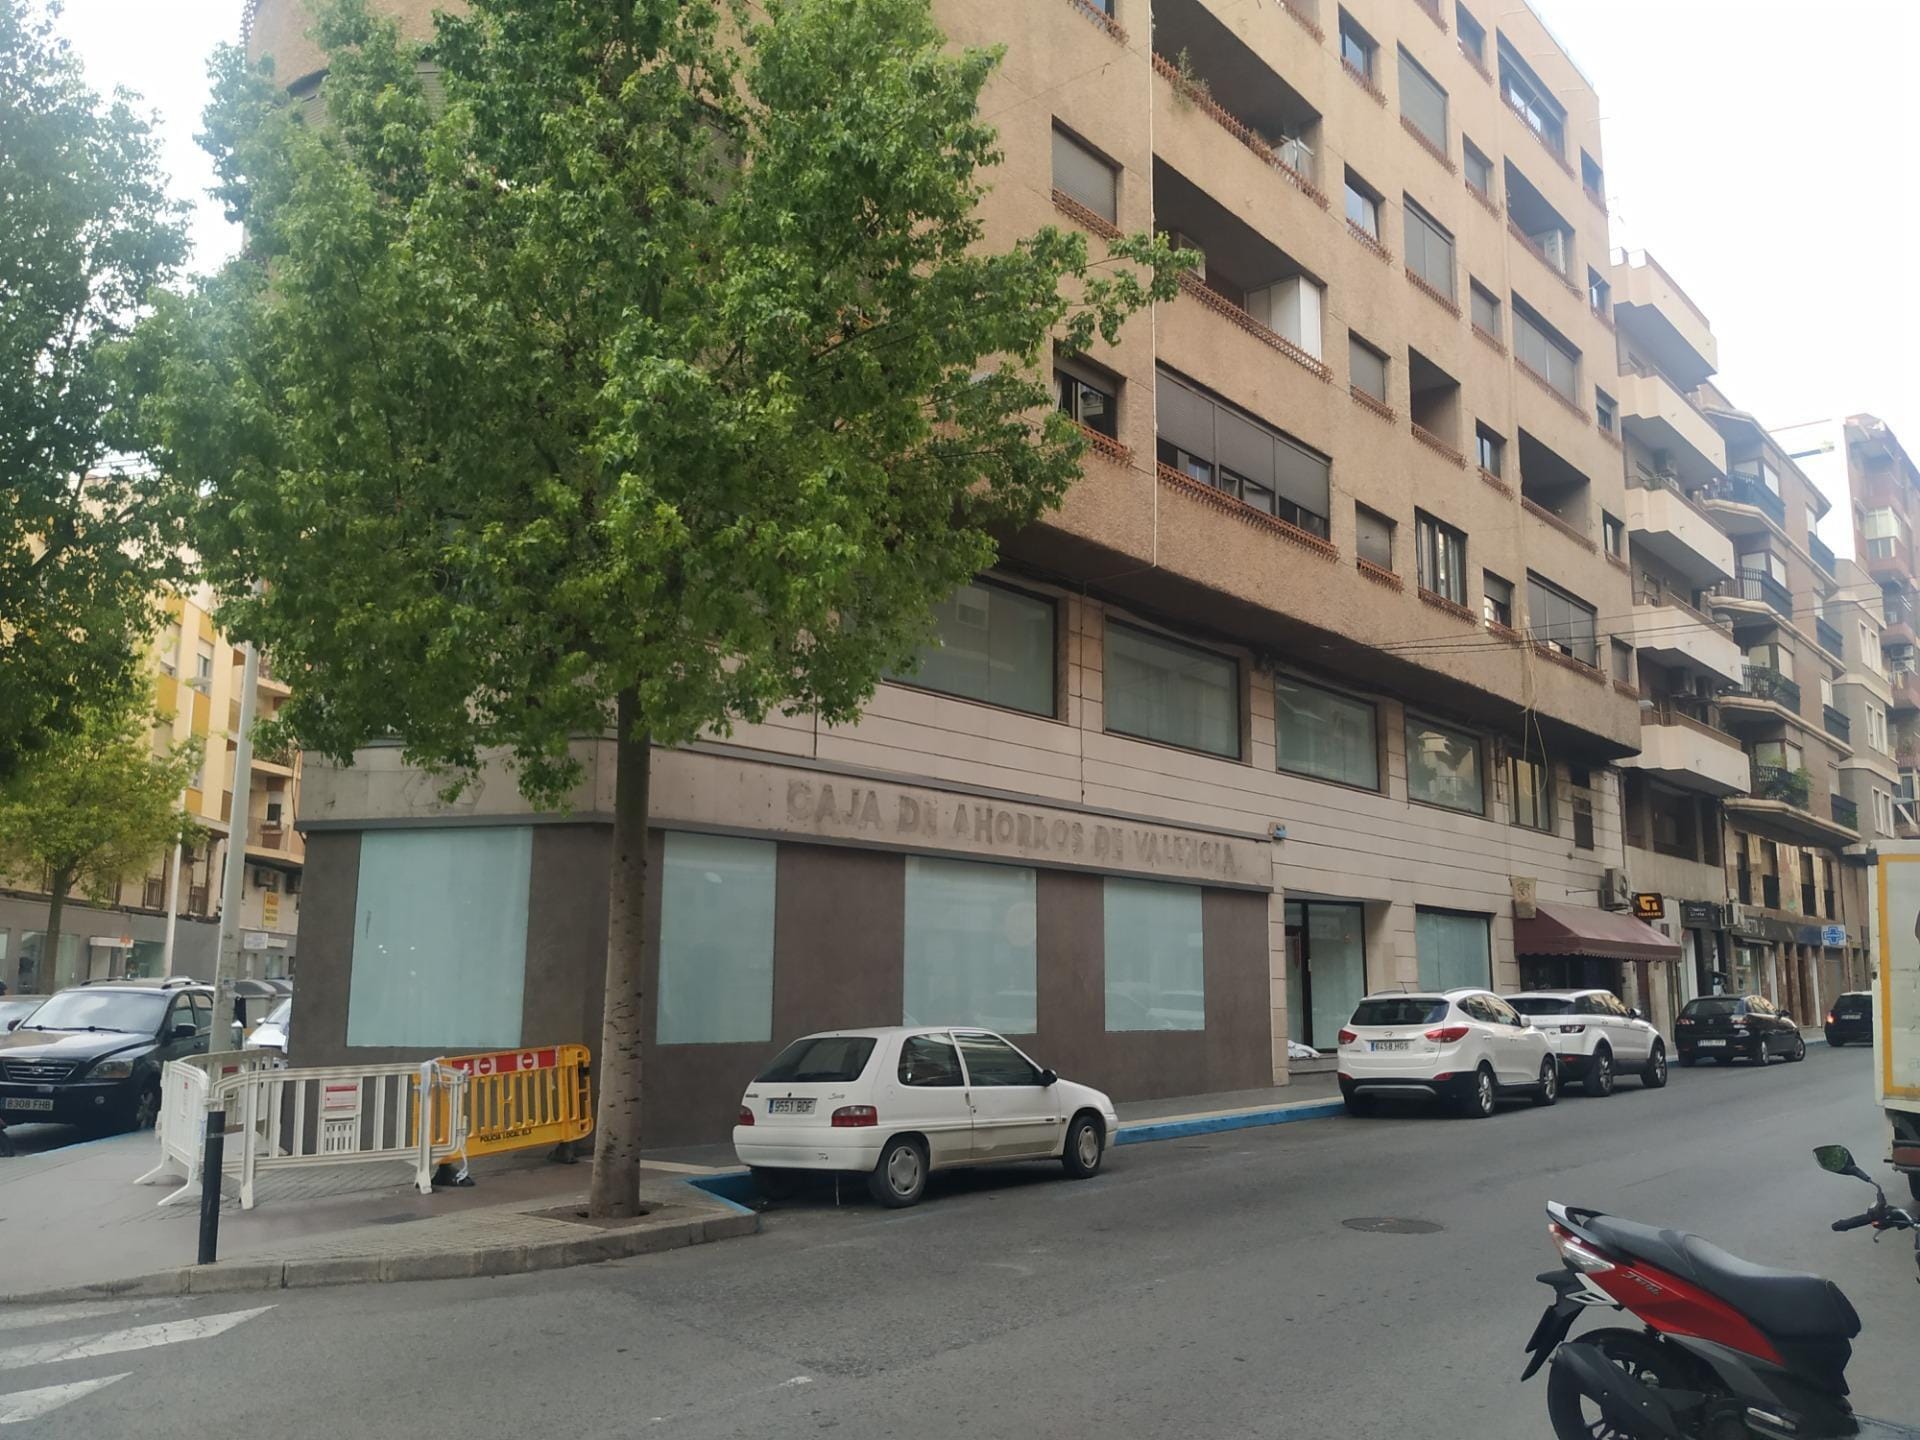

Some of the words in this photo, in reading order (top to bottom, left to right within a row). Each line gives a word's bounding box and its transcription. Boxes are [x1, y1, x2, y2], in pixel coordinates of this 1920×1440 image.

[786, 779, 883, 831] CAJA
[952, 803, 1085, 854] AHORROS
[1133, 829, 1238, 876] VALENCIA
[774, 1101, 794, 1113] 9551
